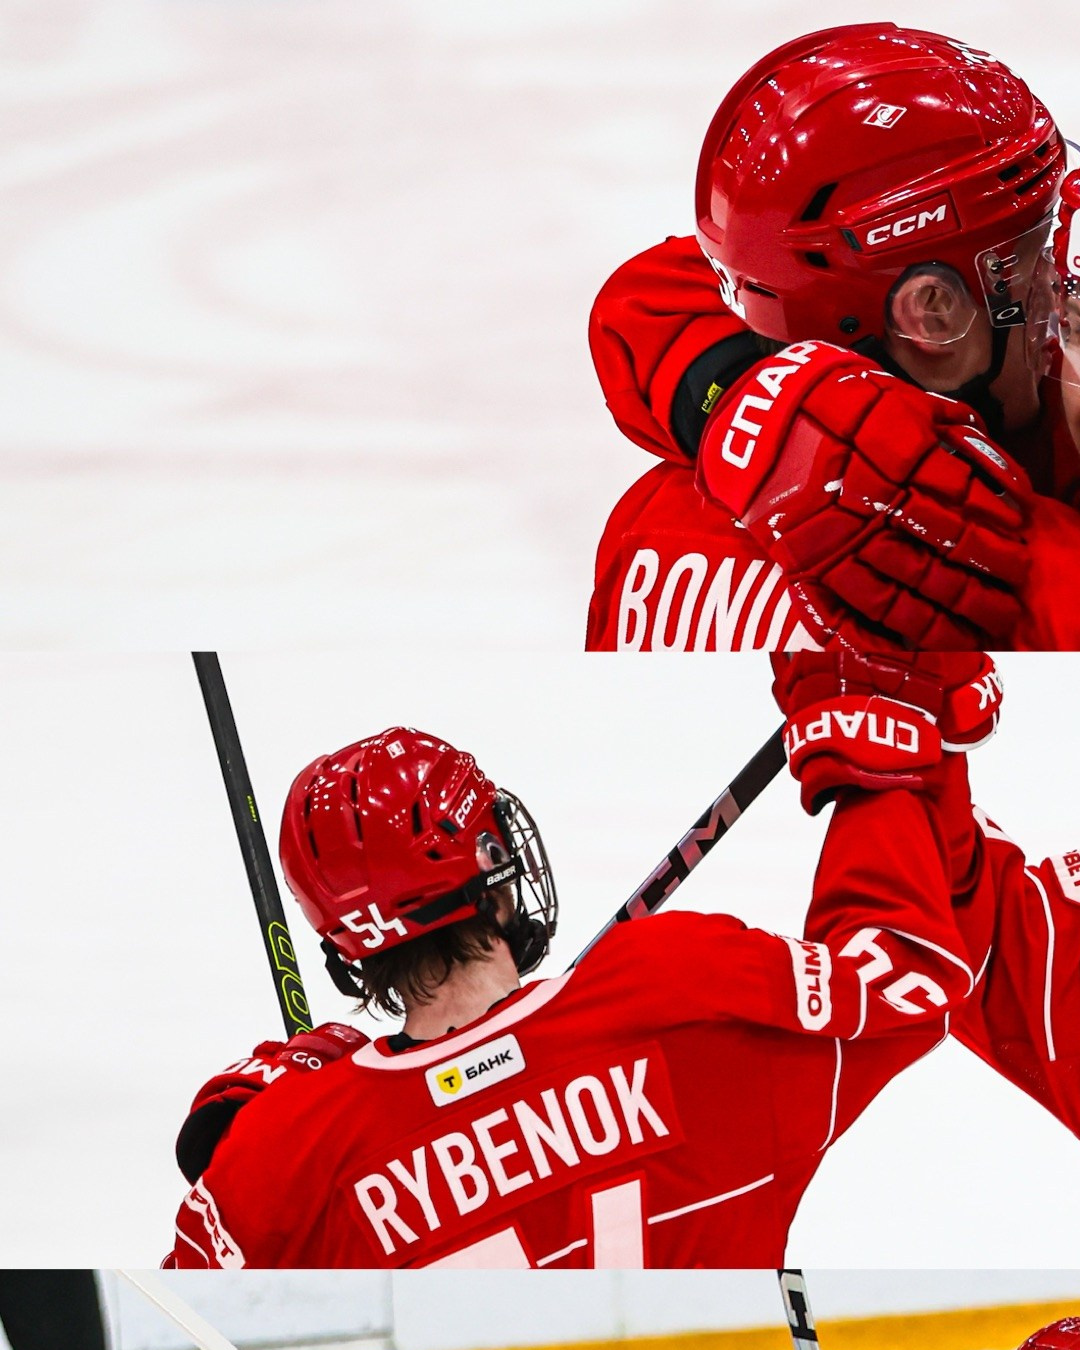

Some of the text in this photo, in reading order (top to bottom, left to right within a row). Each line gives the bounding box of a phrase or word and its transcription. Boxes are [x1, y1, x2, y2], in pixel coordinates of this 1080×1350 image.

[866, 204, 947, 247] CCM
[721, 340, 848, 470] СПАР
[783, 710, 920, 757] СПАРТ
[454, 788, 478, 829] CCM
[486, 865, 517, 887] BAUER
[339, 902, 408, 950] 54
[801, 941, 822, 1017] OLIM
[464, 1049, 514, 1080] БАНК
[353, 1057, 670, 1257] RYBENOK
